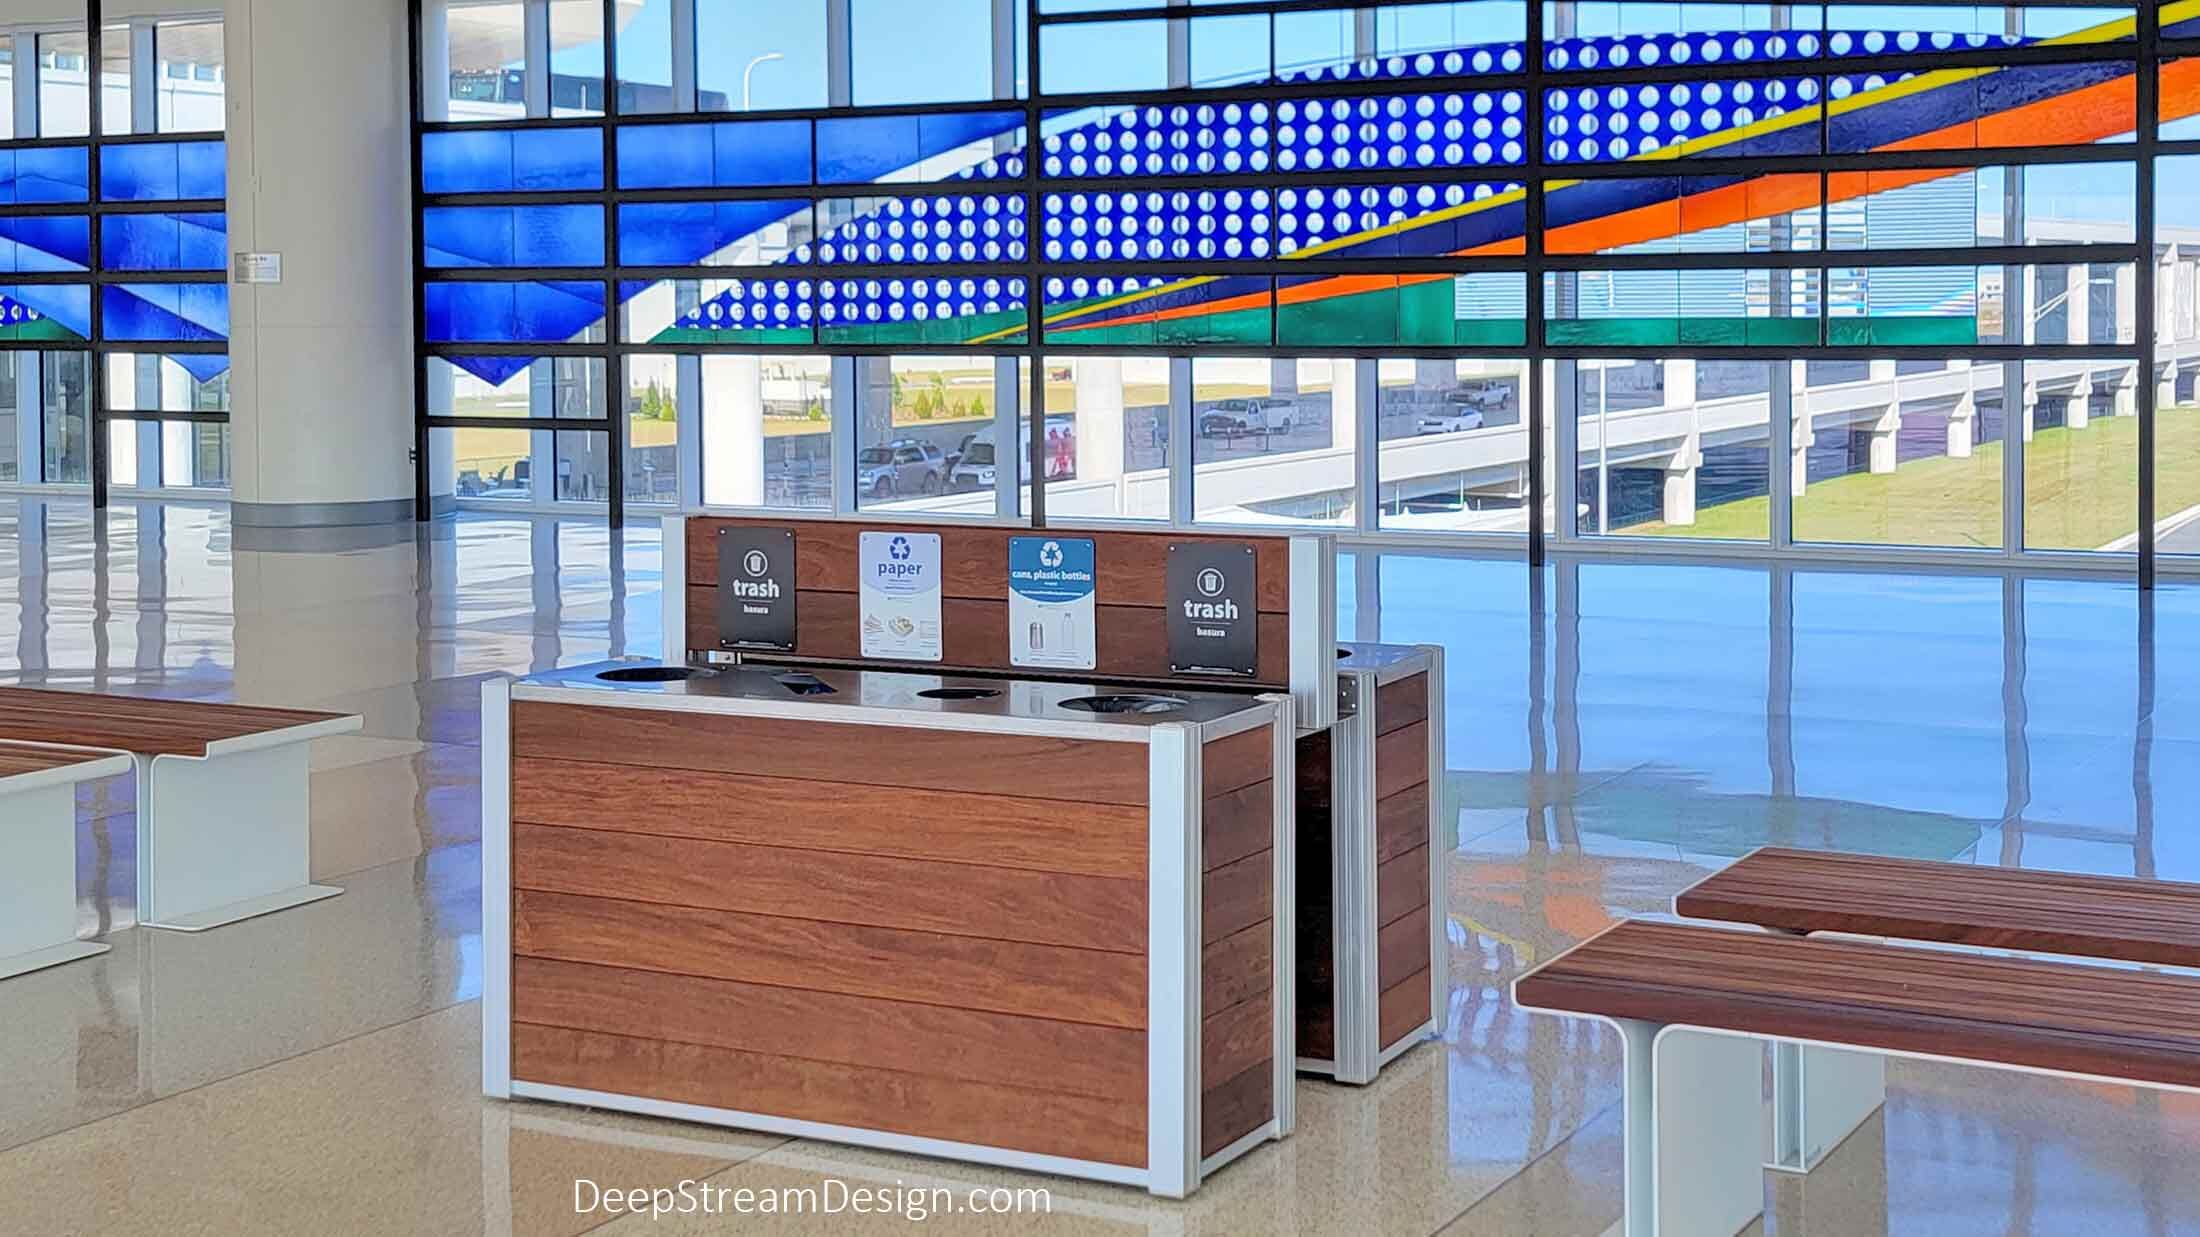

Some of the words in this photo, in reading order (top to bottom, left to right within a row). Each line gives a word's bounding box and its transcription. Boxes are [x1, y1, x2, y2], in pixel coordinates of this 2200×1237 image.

[878, 563, 922, 578] paper
[1033, 569, 1060, 581] plastic
[1061, 570, 1091, 581] bottles
[732, 579, 780, 598] trash
[1183, 599, 1239, 619] trash
[1196, 626, 1226, 637] basura
